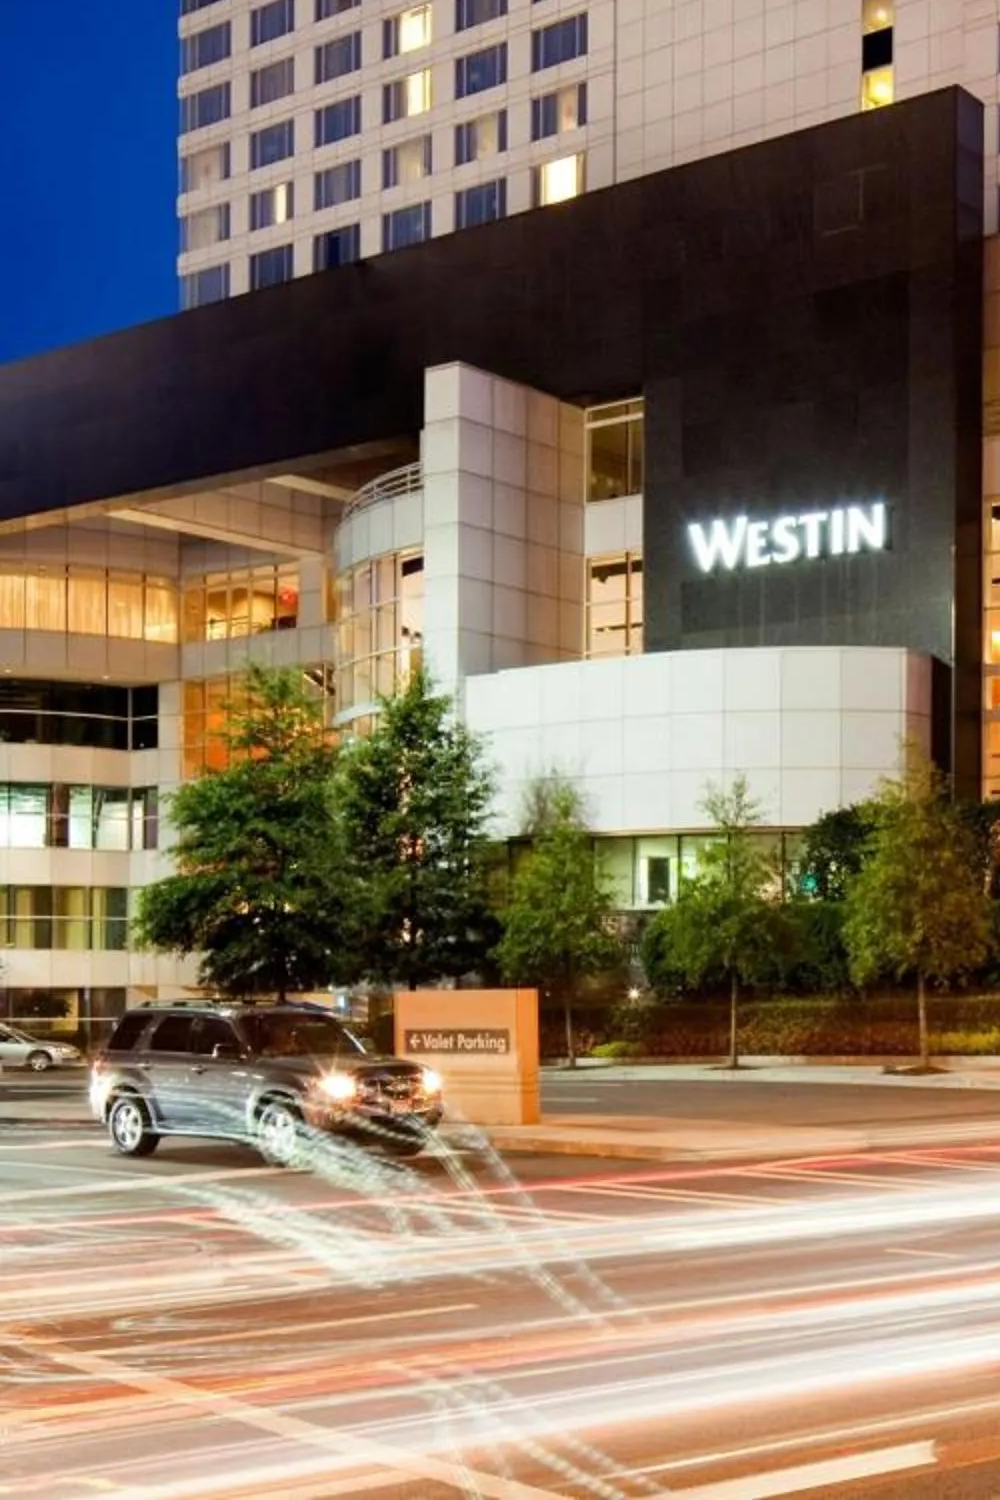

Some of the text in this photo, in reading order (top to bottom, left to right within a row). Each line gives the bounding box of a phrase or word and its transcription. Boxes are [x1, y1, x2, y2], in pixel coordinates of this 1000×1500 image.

[686, 501, 887, 573] WESTIN
[423, 1032, 507, 1053] Valet Parking
